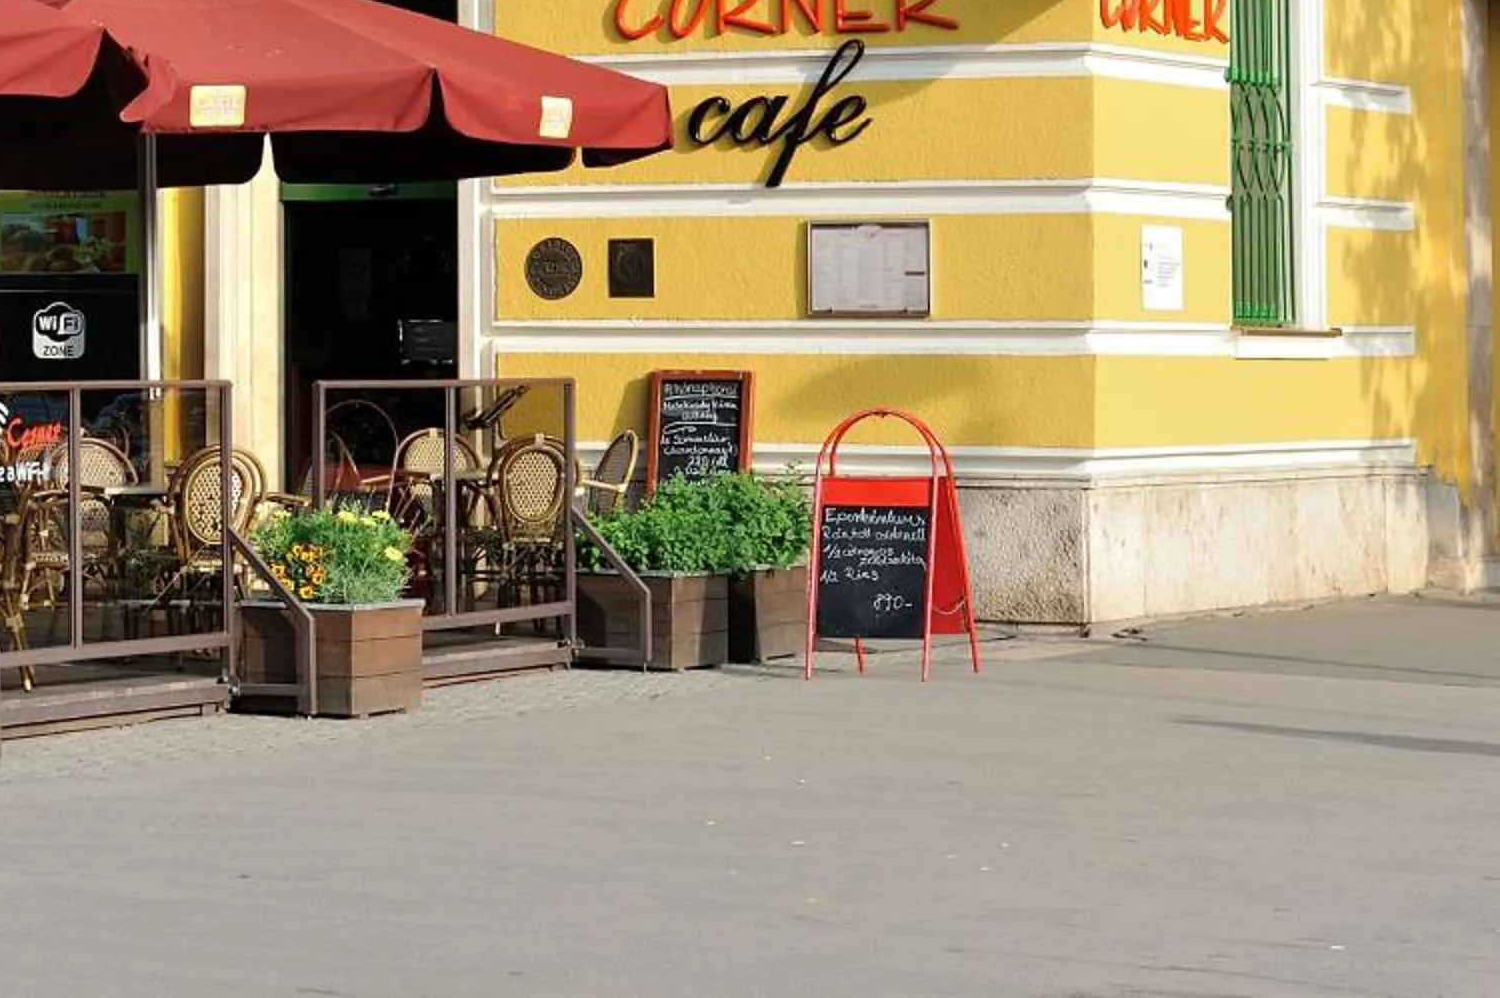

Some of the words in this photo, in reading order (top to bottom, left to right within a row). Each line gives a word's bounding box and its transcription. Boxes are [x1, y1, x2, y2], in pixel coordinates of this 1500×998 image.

[687, 38, 873, 188] cafe
[43, 345, 75, 357] ZONE
[7, 466, 15, 481] a
